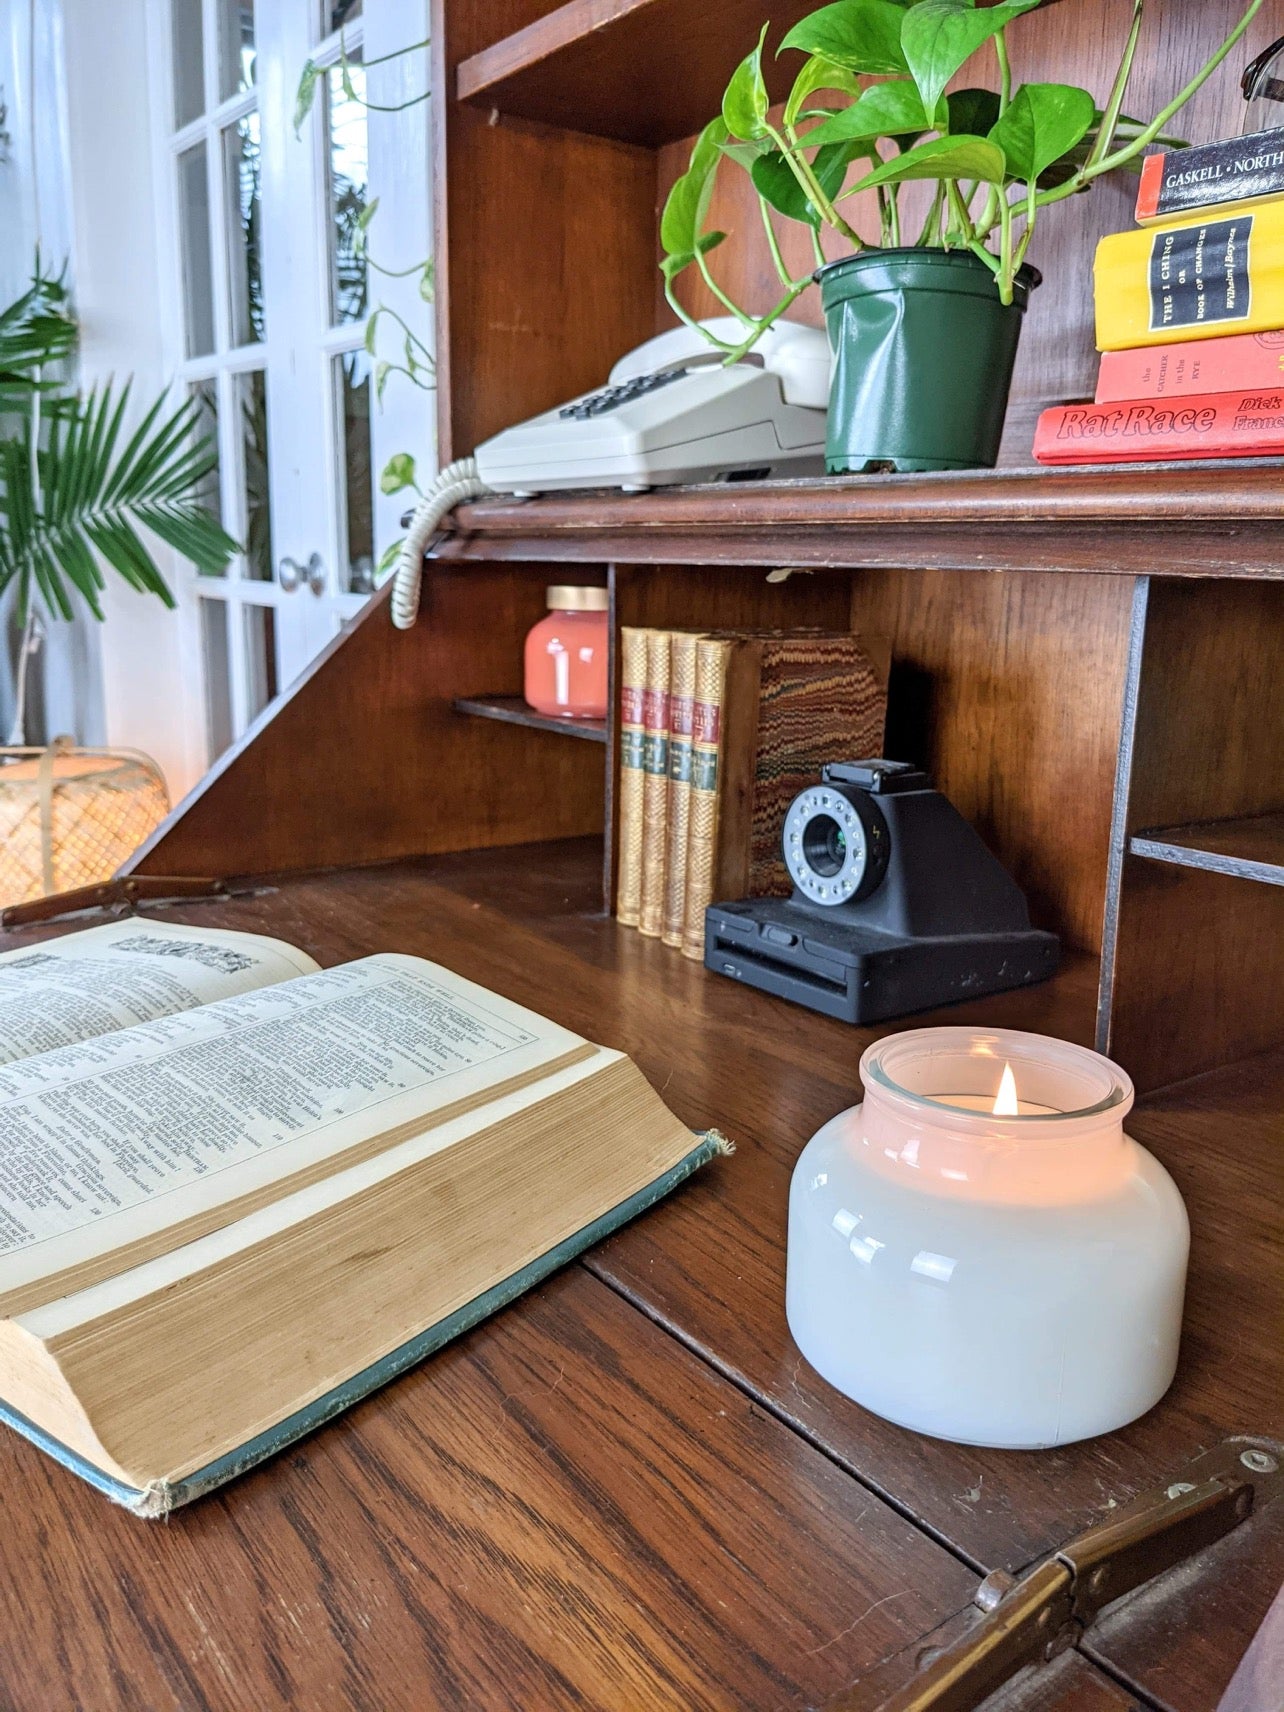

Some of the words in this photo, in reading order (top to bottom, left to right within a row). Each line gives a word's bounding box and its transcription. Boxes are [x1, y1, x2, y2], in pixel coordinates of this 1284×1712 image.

[1166, 165, 1223, 188] GASKELL
[1233, 151, 1284, 174] NORTH
[1161, 236, 1174, 280] CHING
[1195, 229, 1207, 274] CHANGES
[1178, 269, 1186, 284] OR
[1195, 278, 1204, 291] OF
[1163, 295, 1173, 323] THE
[1196, 294, 1205, 320] BOOK
[1142, 367, 1152, 383] the
[1157, 354, 1169, 393] CATCHER
[1175, 359, 1185, 374] the
[1191, 360, 1201, 379] RYE
[1175, 375, 1183, 384] in
[1238, 396, 1282, 411] Dick
[1057, 410, 1123, 440] Rat
[1123, 405, 1216, 438] Race
